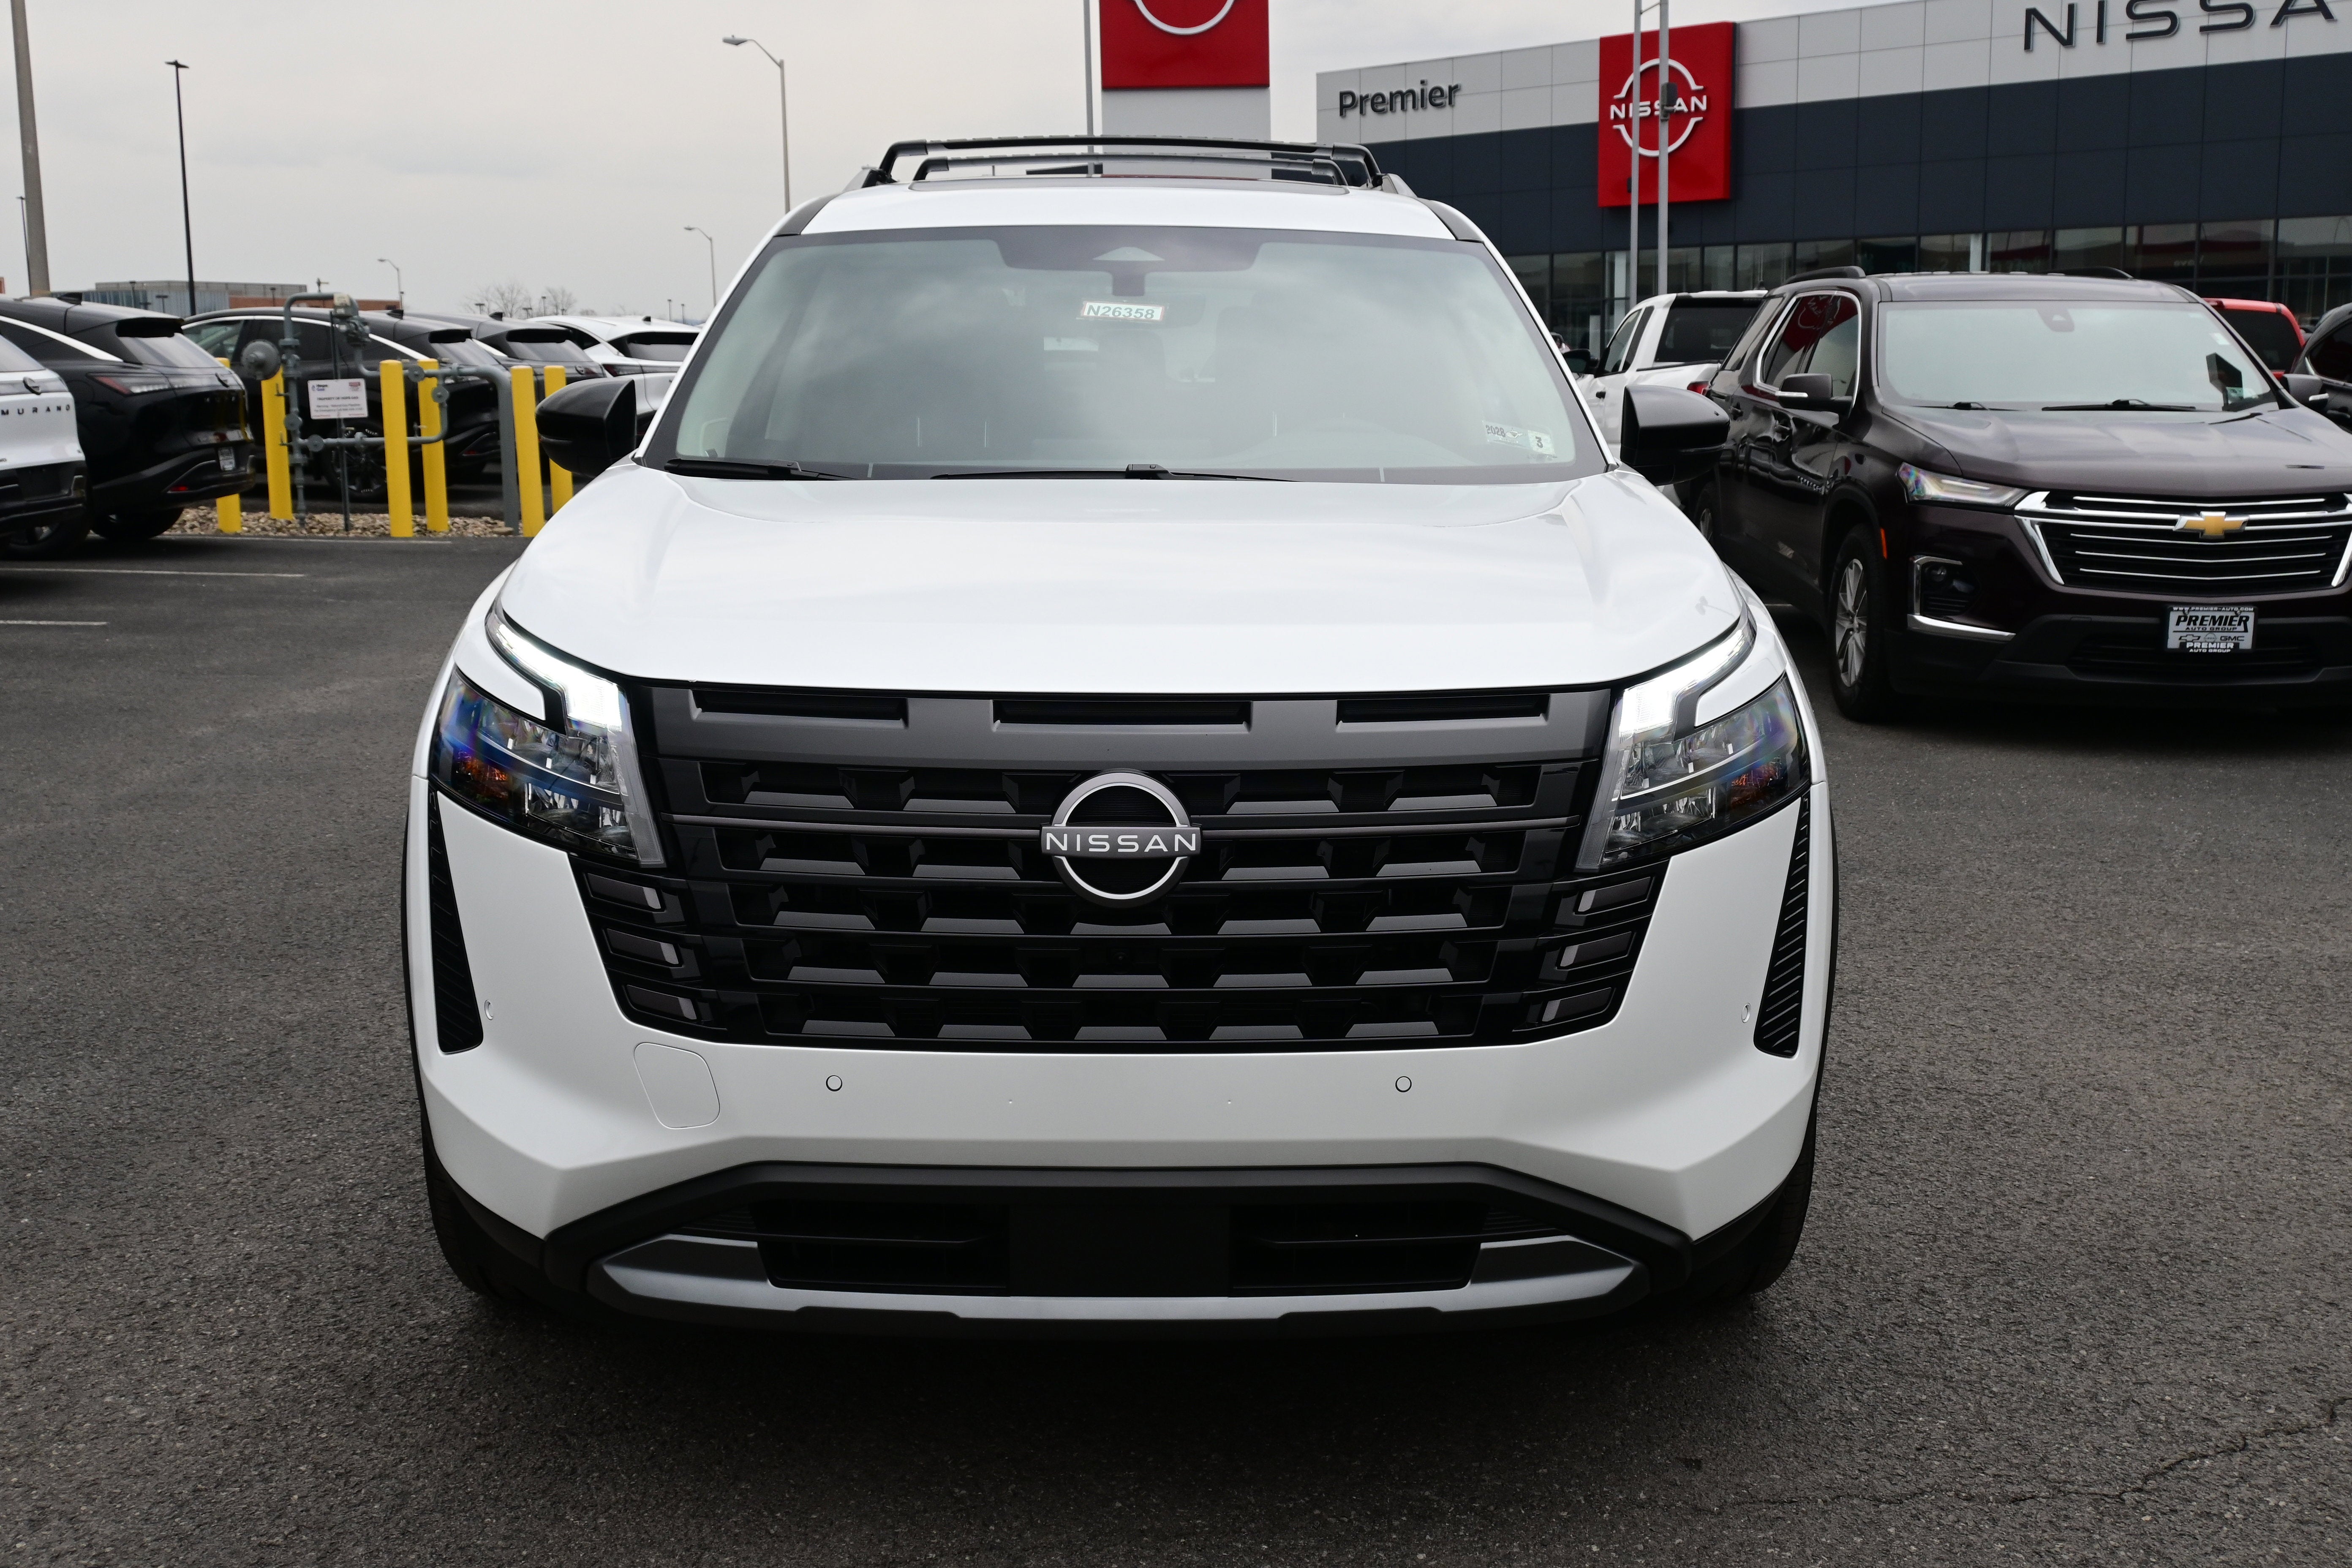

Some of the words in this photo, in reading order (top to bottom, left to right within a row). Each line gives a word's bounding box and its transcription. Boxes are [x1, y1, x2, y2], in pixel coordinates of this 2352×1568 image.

[1339, 79, 1462, 117] Premier
[1086, 305, 1155, 319] N26358
[1, 404, 70, 416] MURANO
[1485, 425, 1506, 437] 2028
[1535, 436, 1544, 448] 3
[2176, 615, 2250, 627] PREMIER
[1046, 833, 1196, 852] NISSAN
